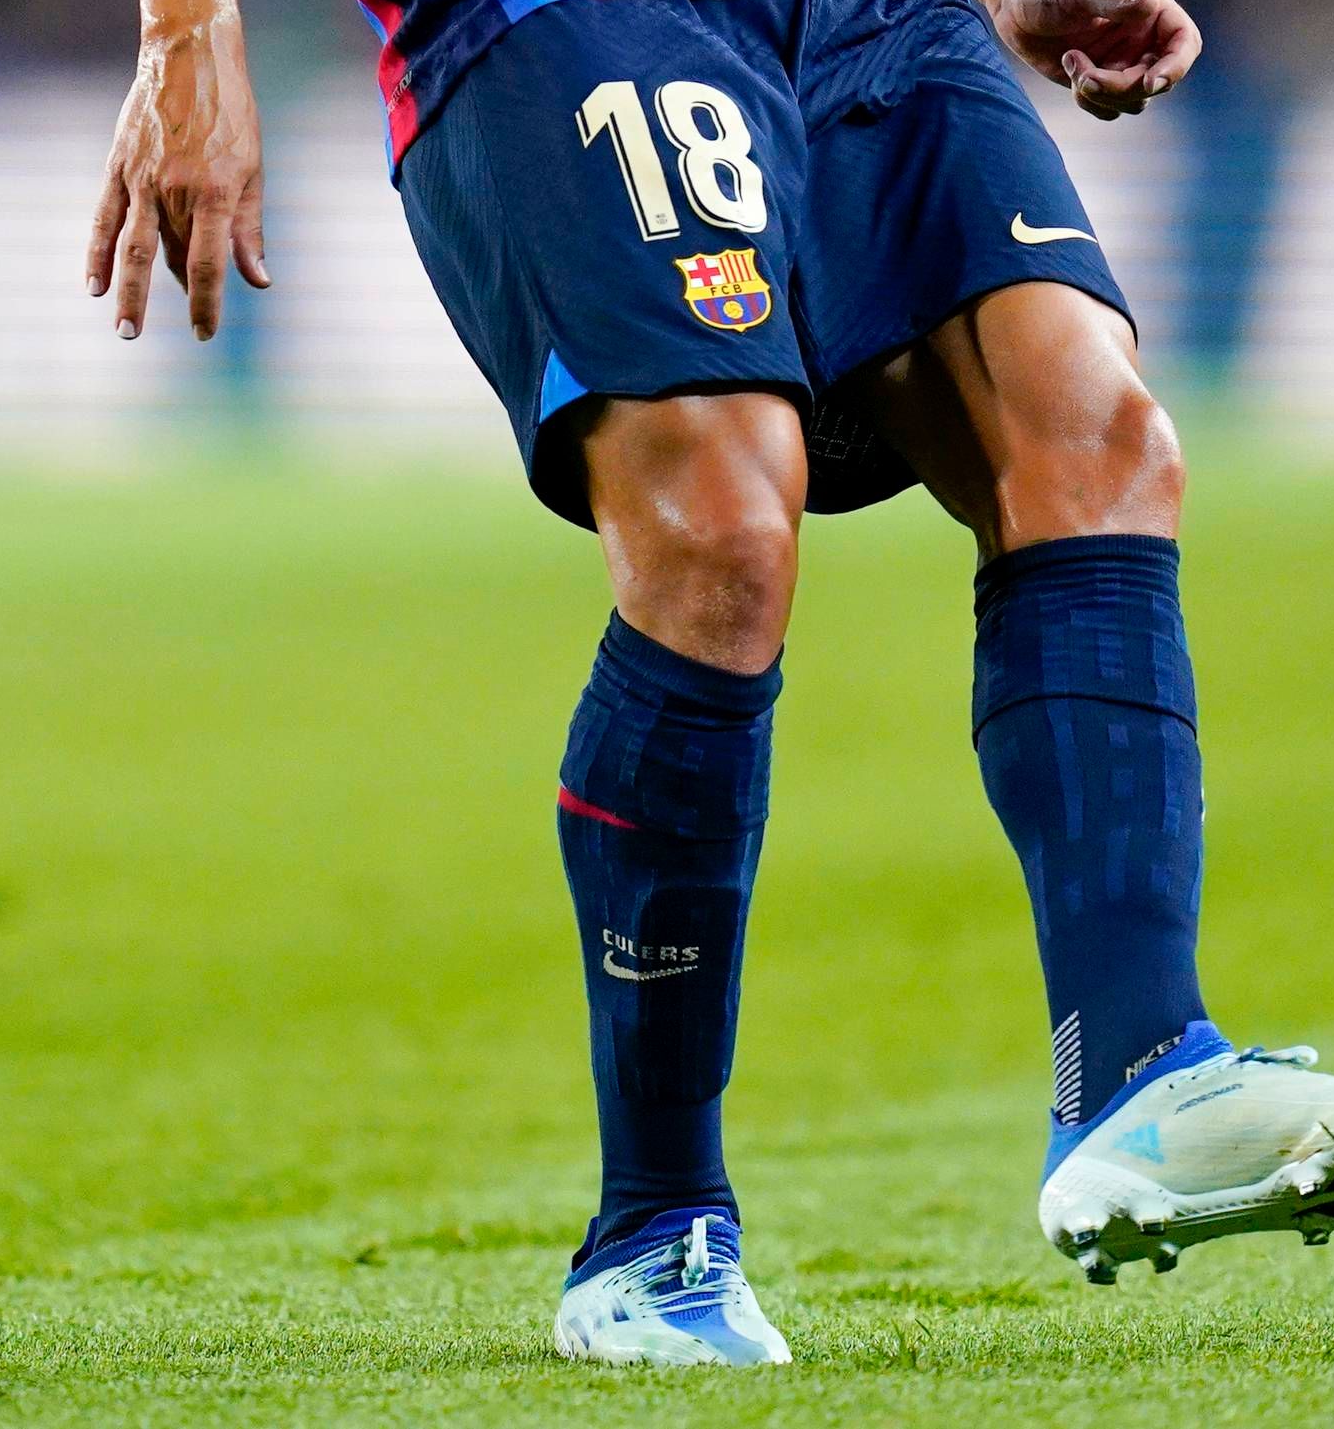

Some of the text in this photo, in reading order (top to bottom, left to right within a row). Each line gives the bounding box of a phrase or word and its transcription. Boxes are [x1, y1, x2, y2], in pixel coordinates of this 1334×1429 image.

[575, 80, 768, 242] 18
[710, 283, 743, 297] FCB
[602, 928, 700, 962] CULERS
